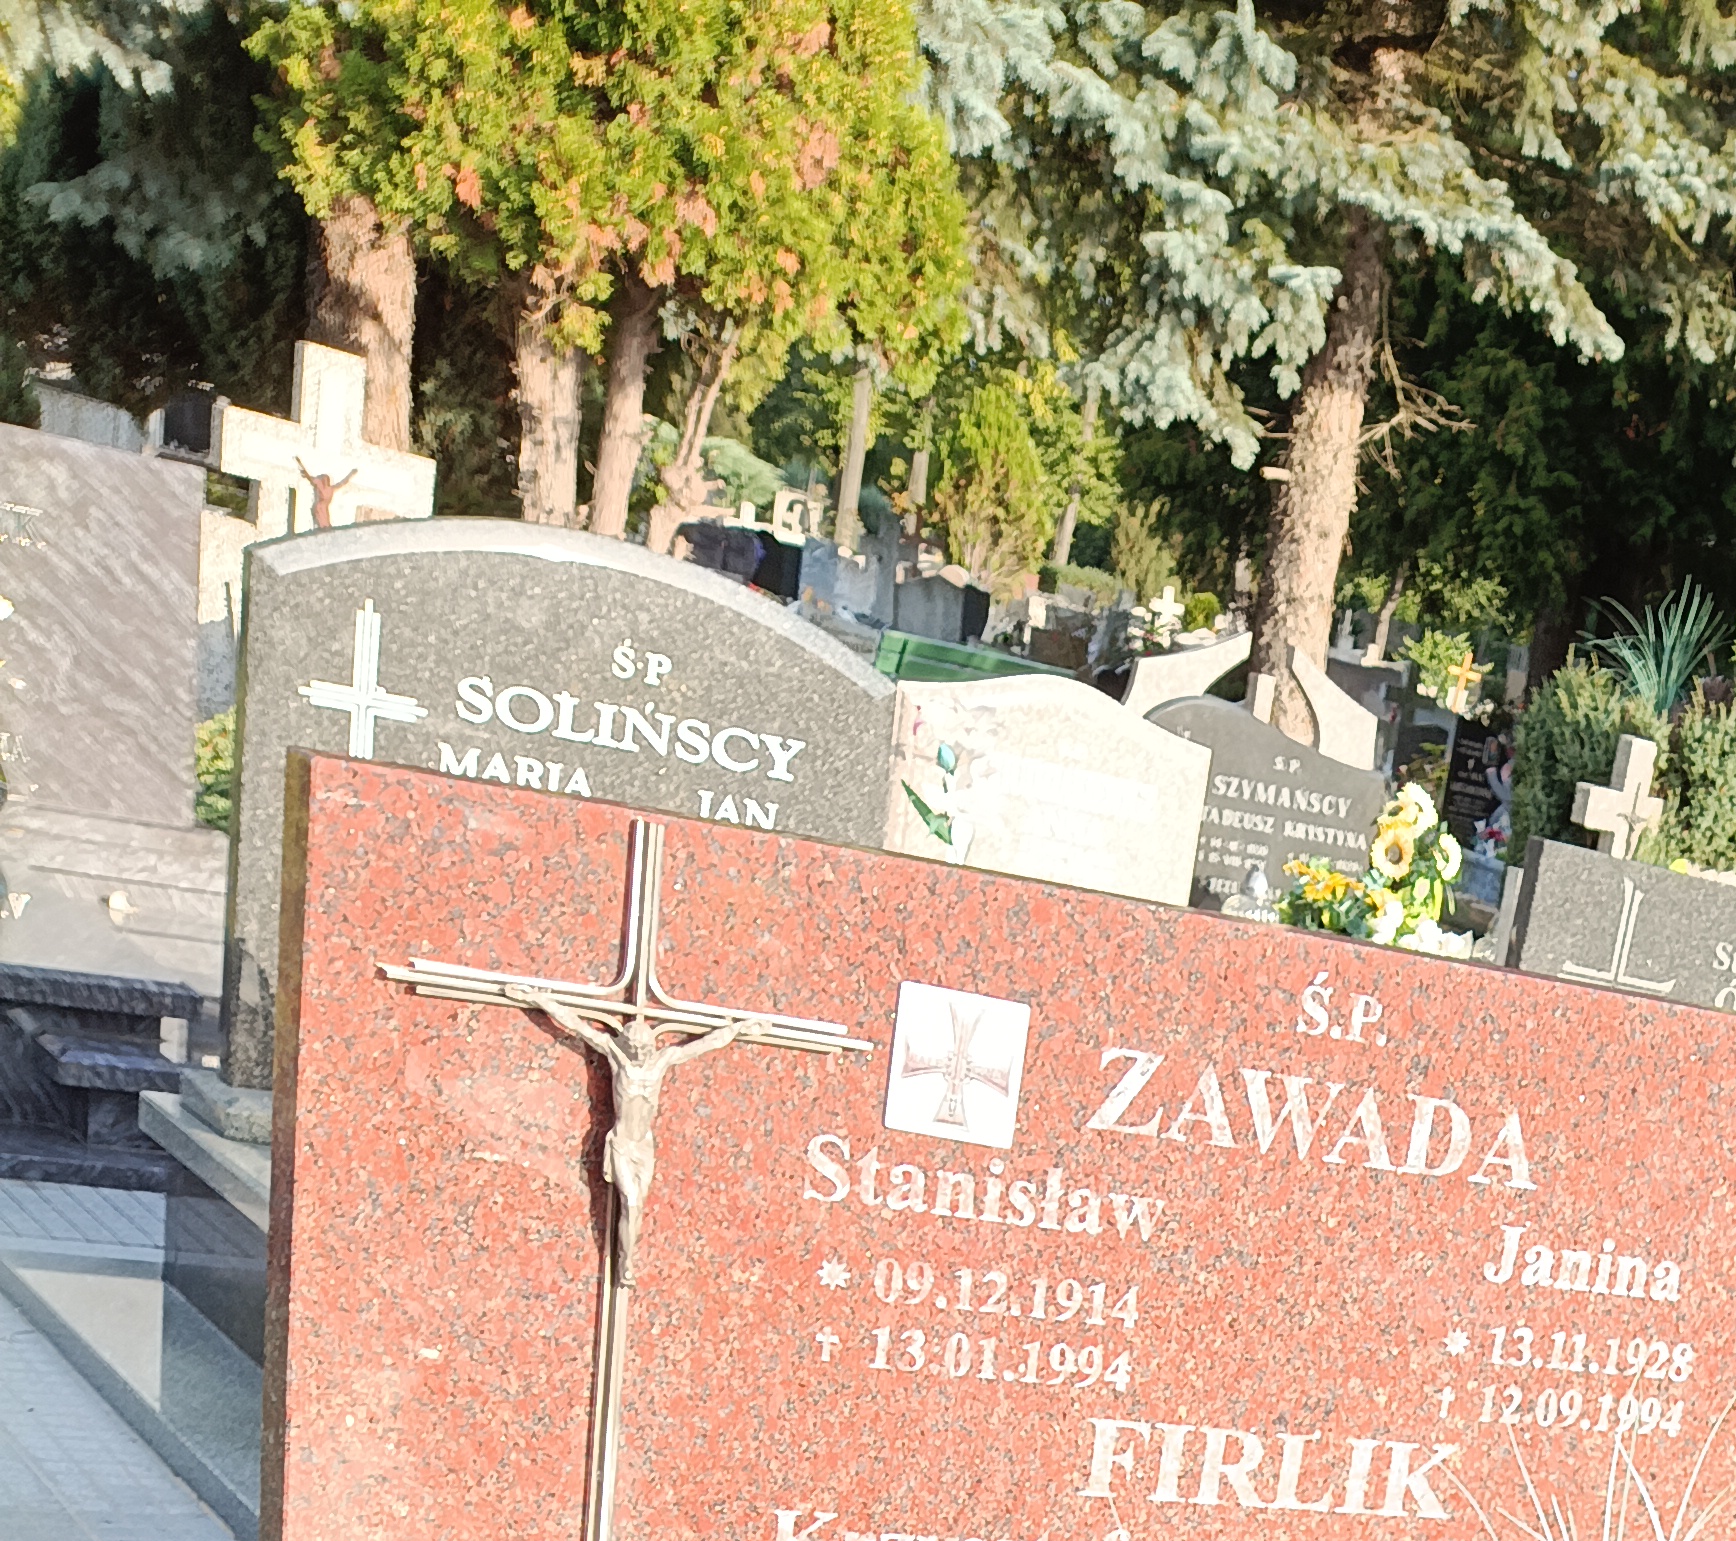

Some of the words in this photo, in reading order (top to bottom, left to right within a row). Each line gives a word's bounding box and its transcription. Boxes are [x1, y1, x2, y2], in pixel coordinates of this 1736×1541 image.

[455, 674, 806, 783] SOLIŃSCY
[438, 742, 592, 798] MARIA
[1211, 773, 1352, 819] SZYMAŃSCY
[1297, 971, 1388, 1047] Ś.P.
[1085, 1047, 1538, 1191] ZAWADA
[803, 1133, 1166, 1243] Stanisław
[1483, 1221, 1681, 1302] Janina
[873, 1256, 1140, 1329] 09.12.1914
[1489, 1325, 1693, 1383] 13.11.1928
[1076, 1416, 1460, 1521] FIRLIK
